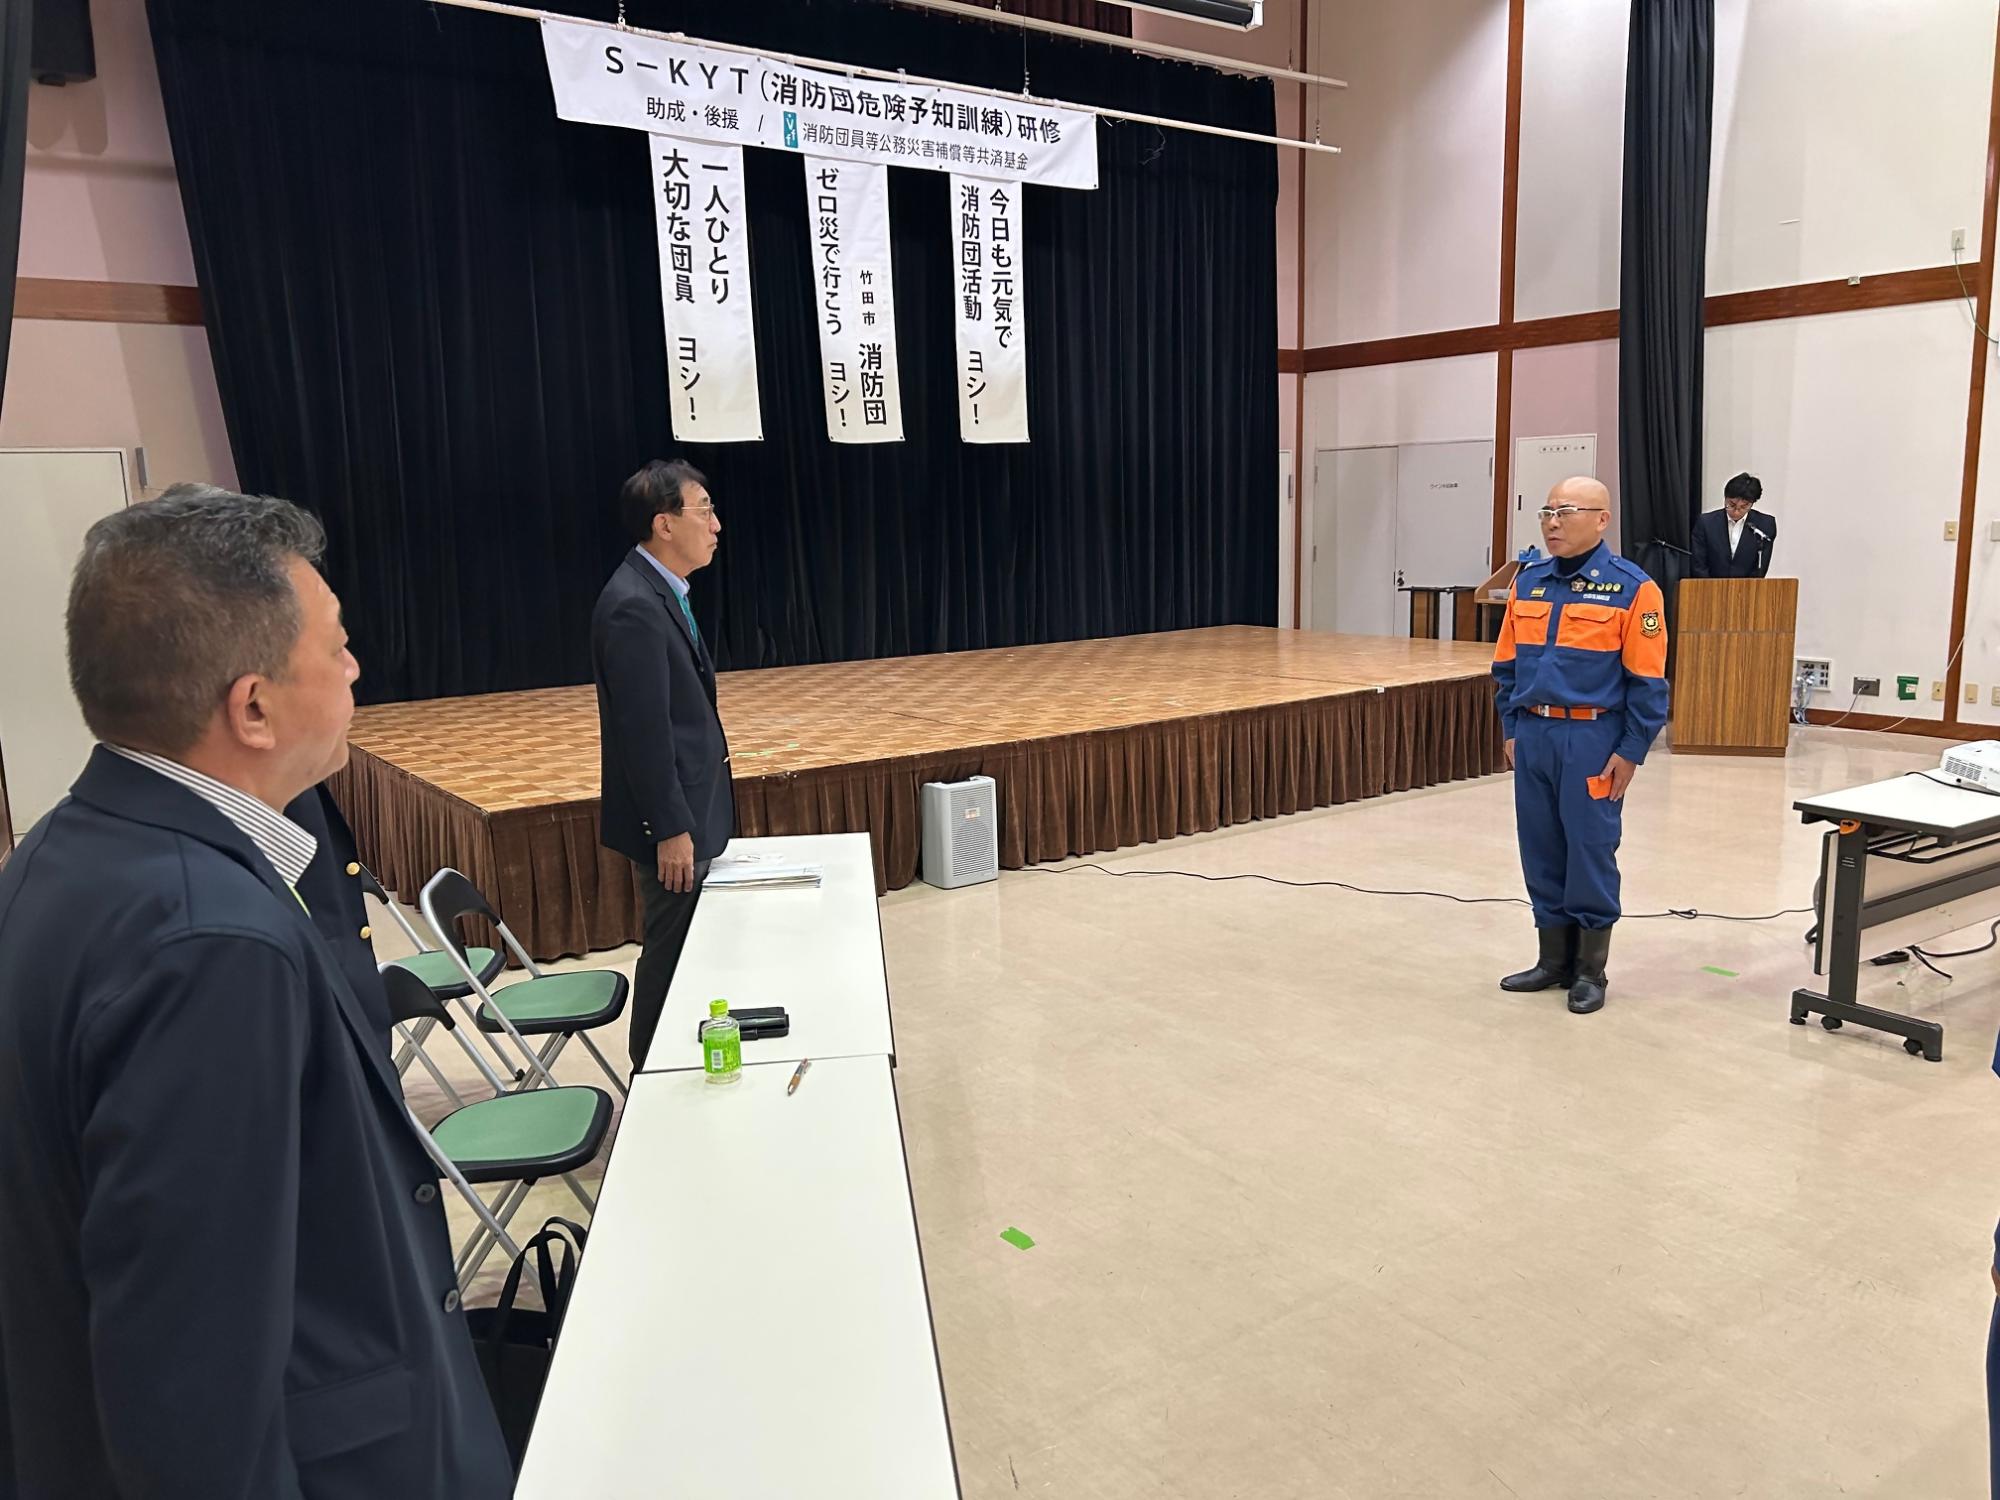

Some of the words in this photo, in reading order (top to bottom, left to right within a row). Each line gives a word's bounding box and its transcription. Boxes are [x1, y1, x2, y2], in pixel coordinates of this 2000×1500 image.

[646, 97, 740, 131] 助成・後援
[802, 121, 1029, 171] 消防団員等公務災害補償等共済基金
[662, 148, 695, 304] 大切な団員
[702, 163, 730, 304] 一人ひとり
[816, 167, 842, 335] ゼロ災で行こう
[961, 184, 983, 321] 消防団活動
[989, 188, 1014, 349] 今日も元気で
[859, 269, 876, 326] 竹田市
[858, 343, 887, 425] 消防団
